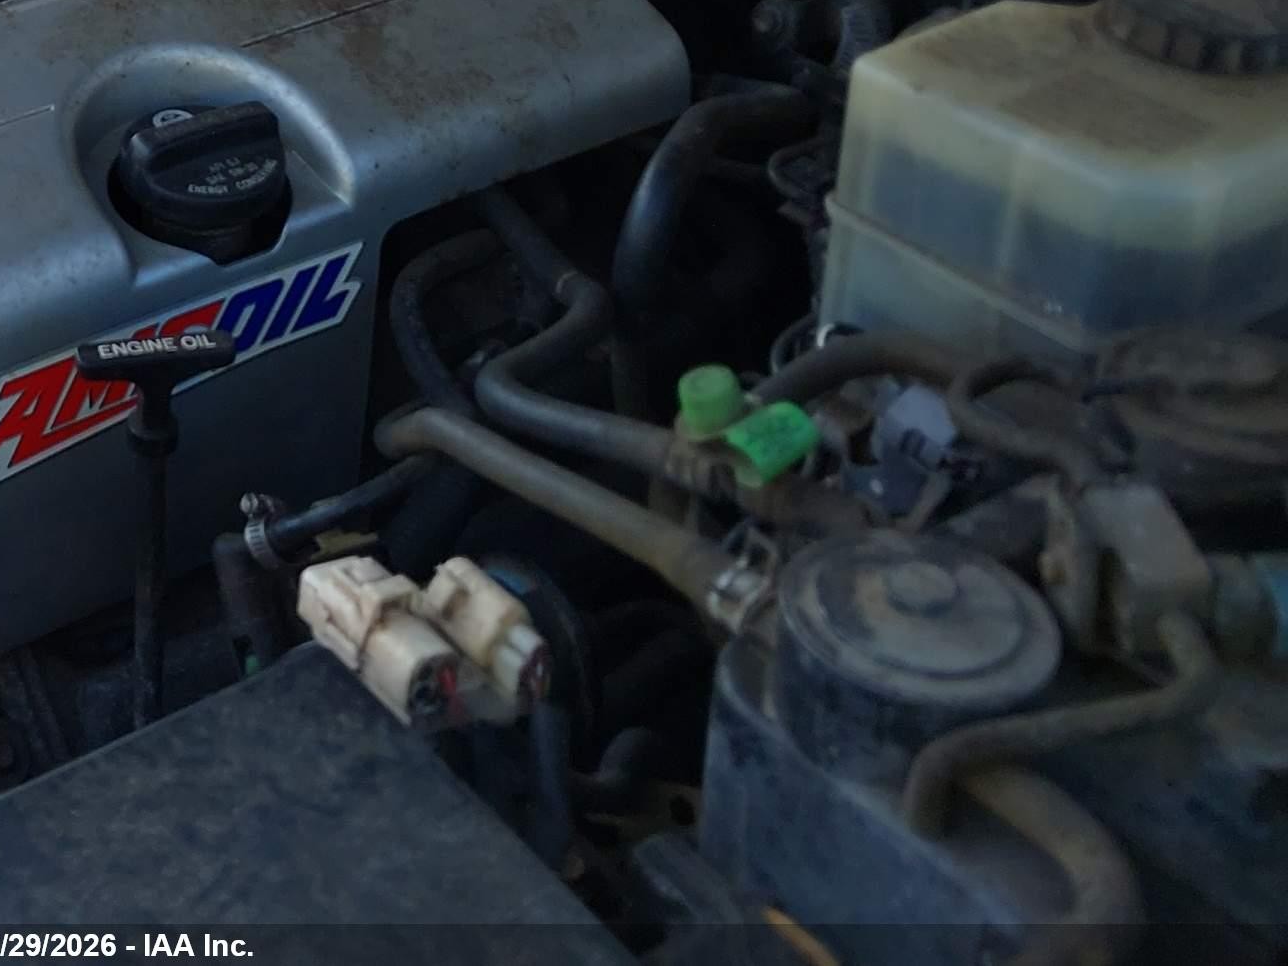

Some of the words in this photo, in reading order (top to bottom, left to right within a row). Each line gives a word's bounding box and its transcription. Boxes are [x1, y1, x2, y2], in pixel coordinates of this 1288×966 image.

[187, 184, 228, 194] ENERGY
[97, 336, 178, 361] ENGINE
[179, 333, 217, 351] OIL
